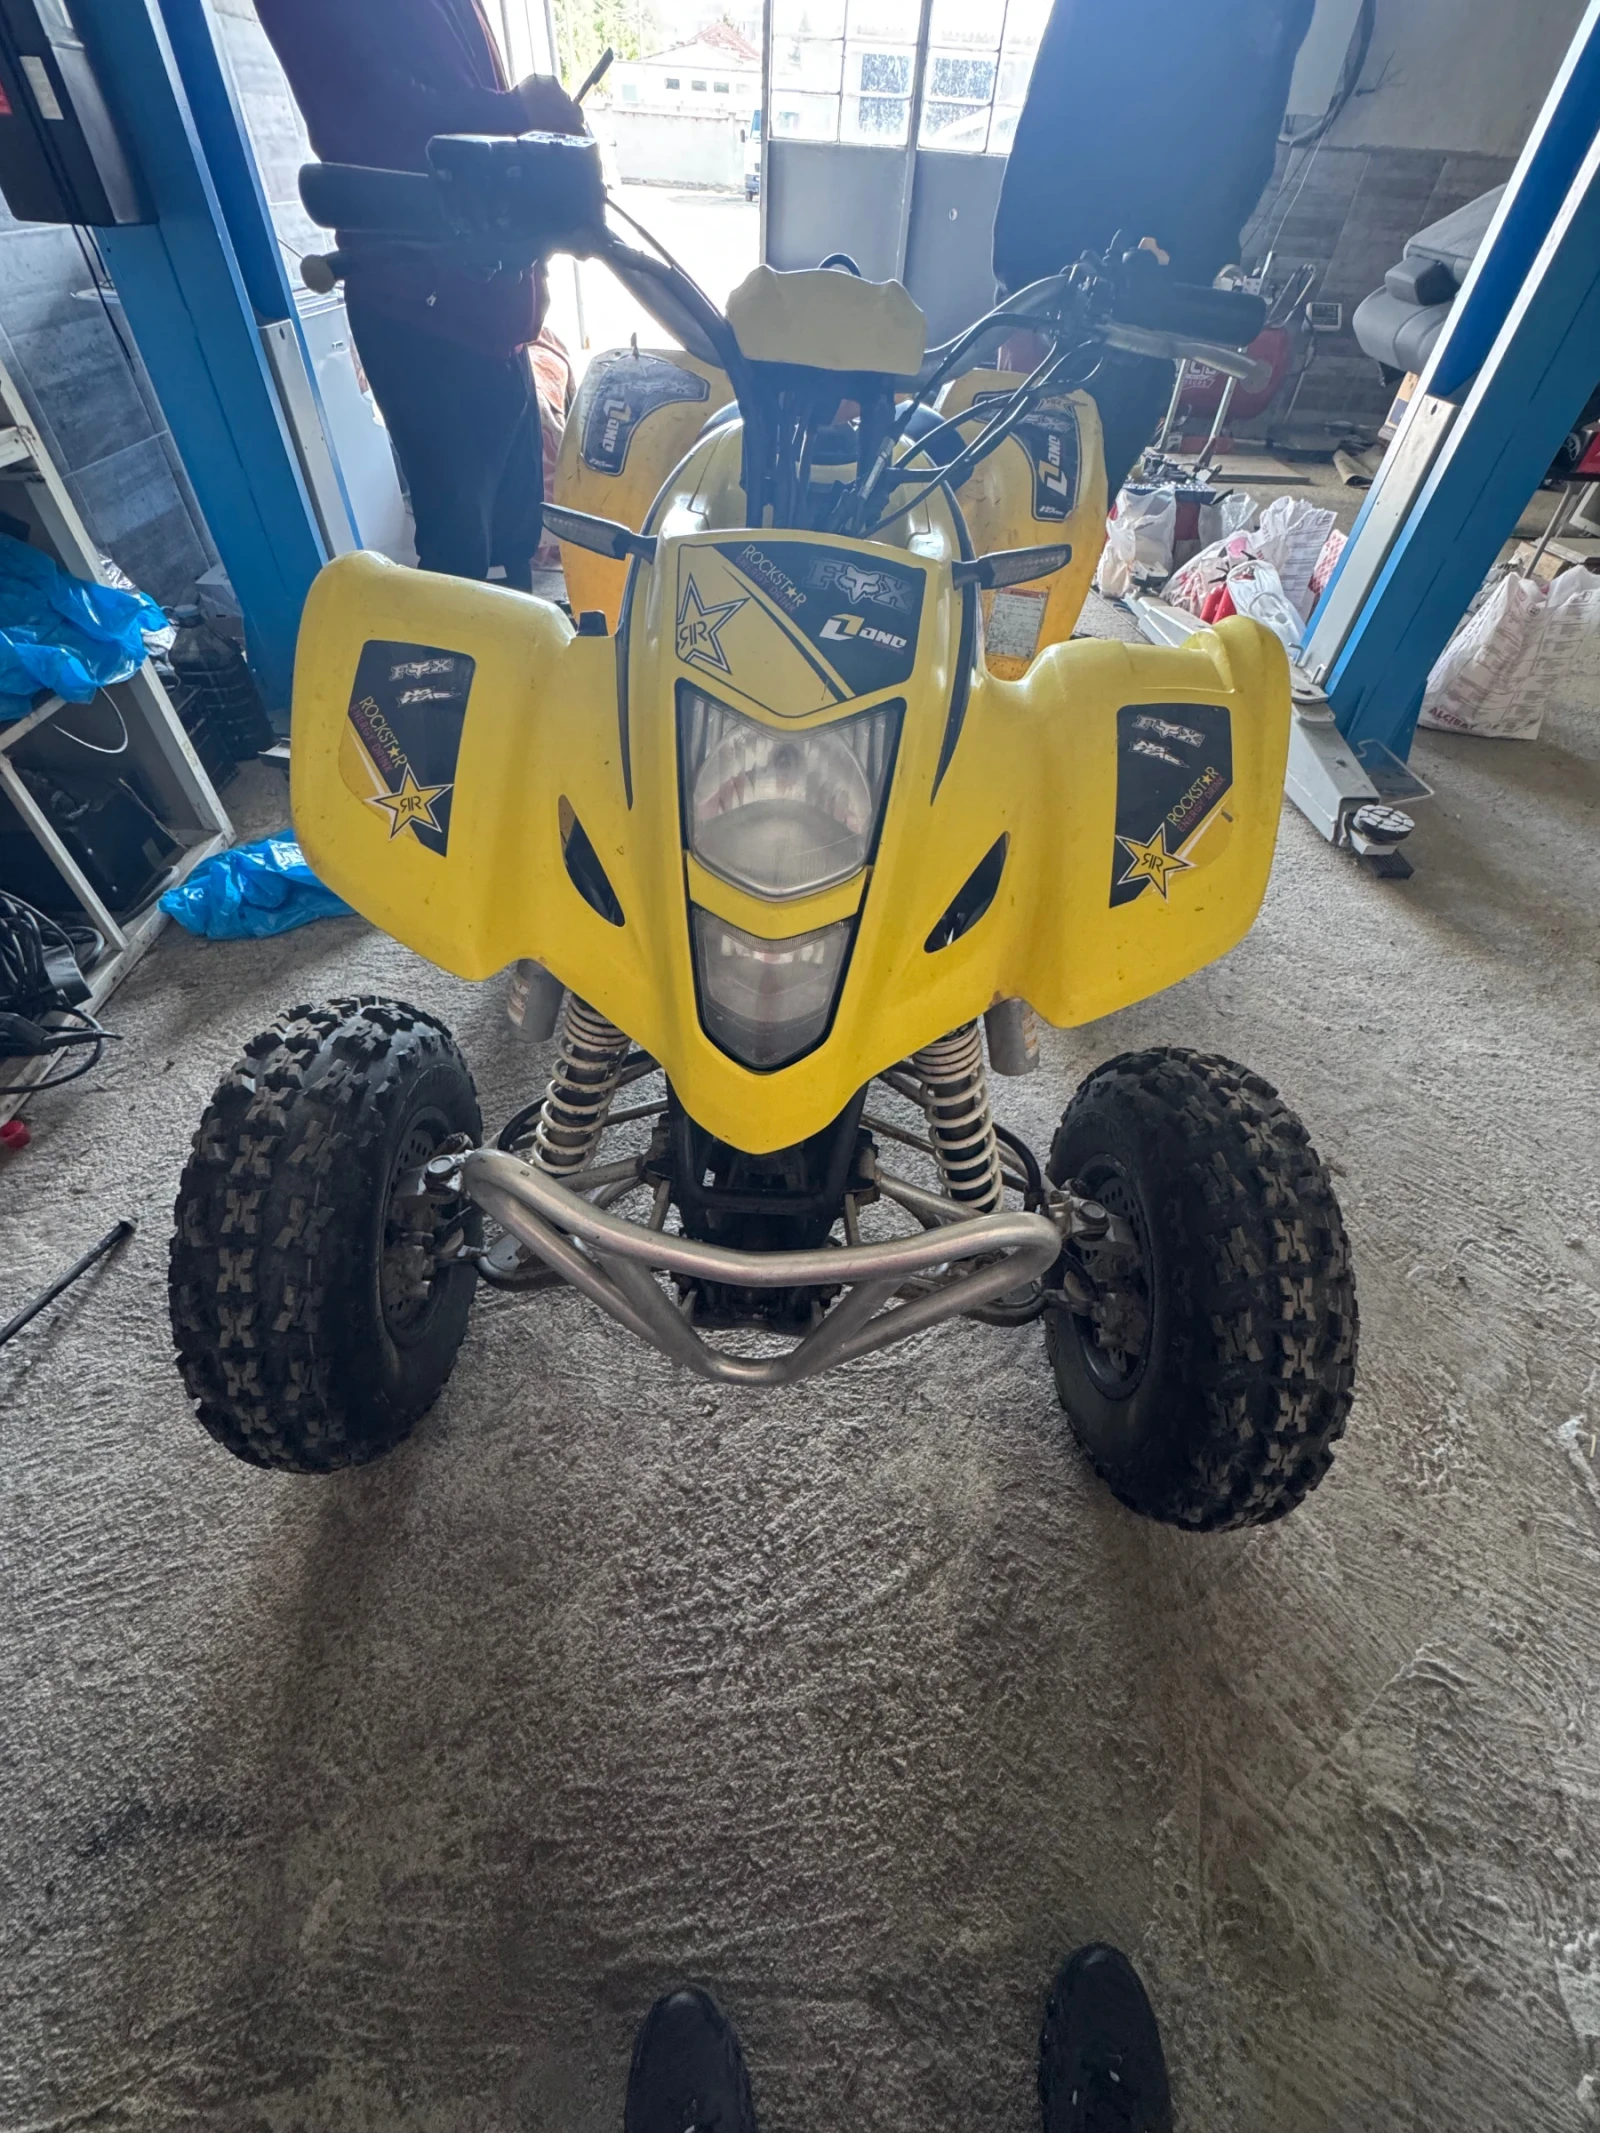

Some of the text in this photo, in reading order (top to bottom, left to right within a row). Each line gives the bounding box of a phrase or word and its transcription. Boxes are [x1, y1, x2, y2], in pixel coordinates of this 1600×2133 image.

[350, 703, 393, 774] ENERGY DRINK
[1177, 775, 1226, 833] ENERGY DRINK
